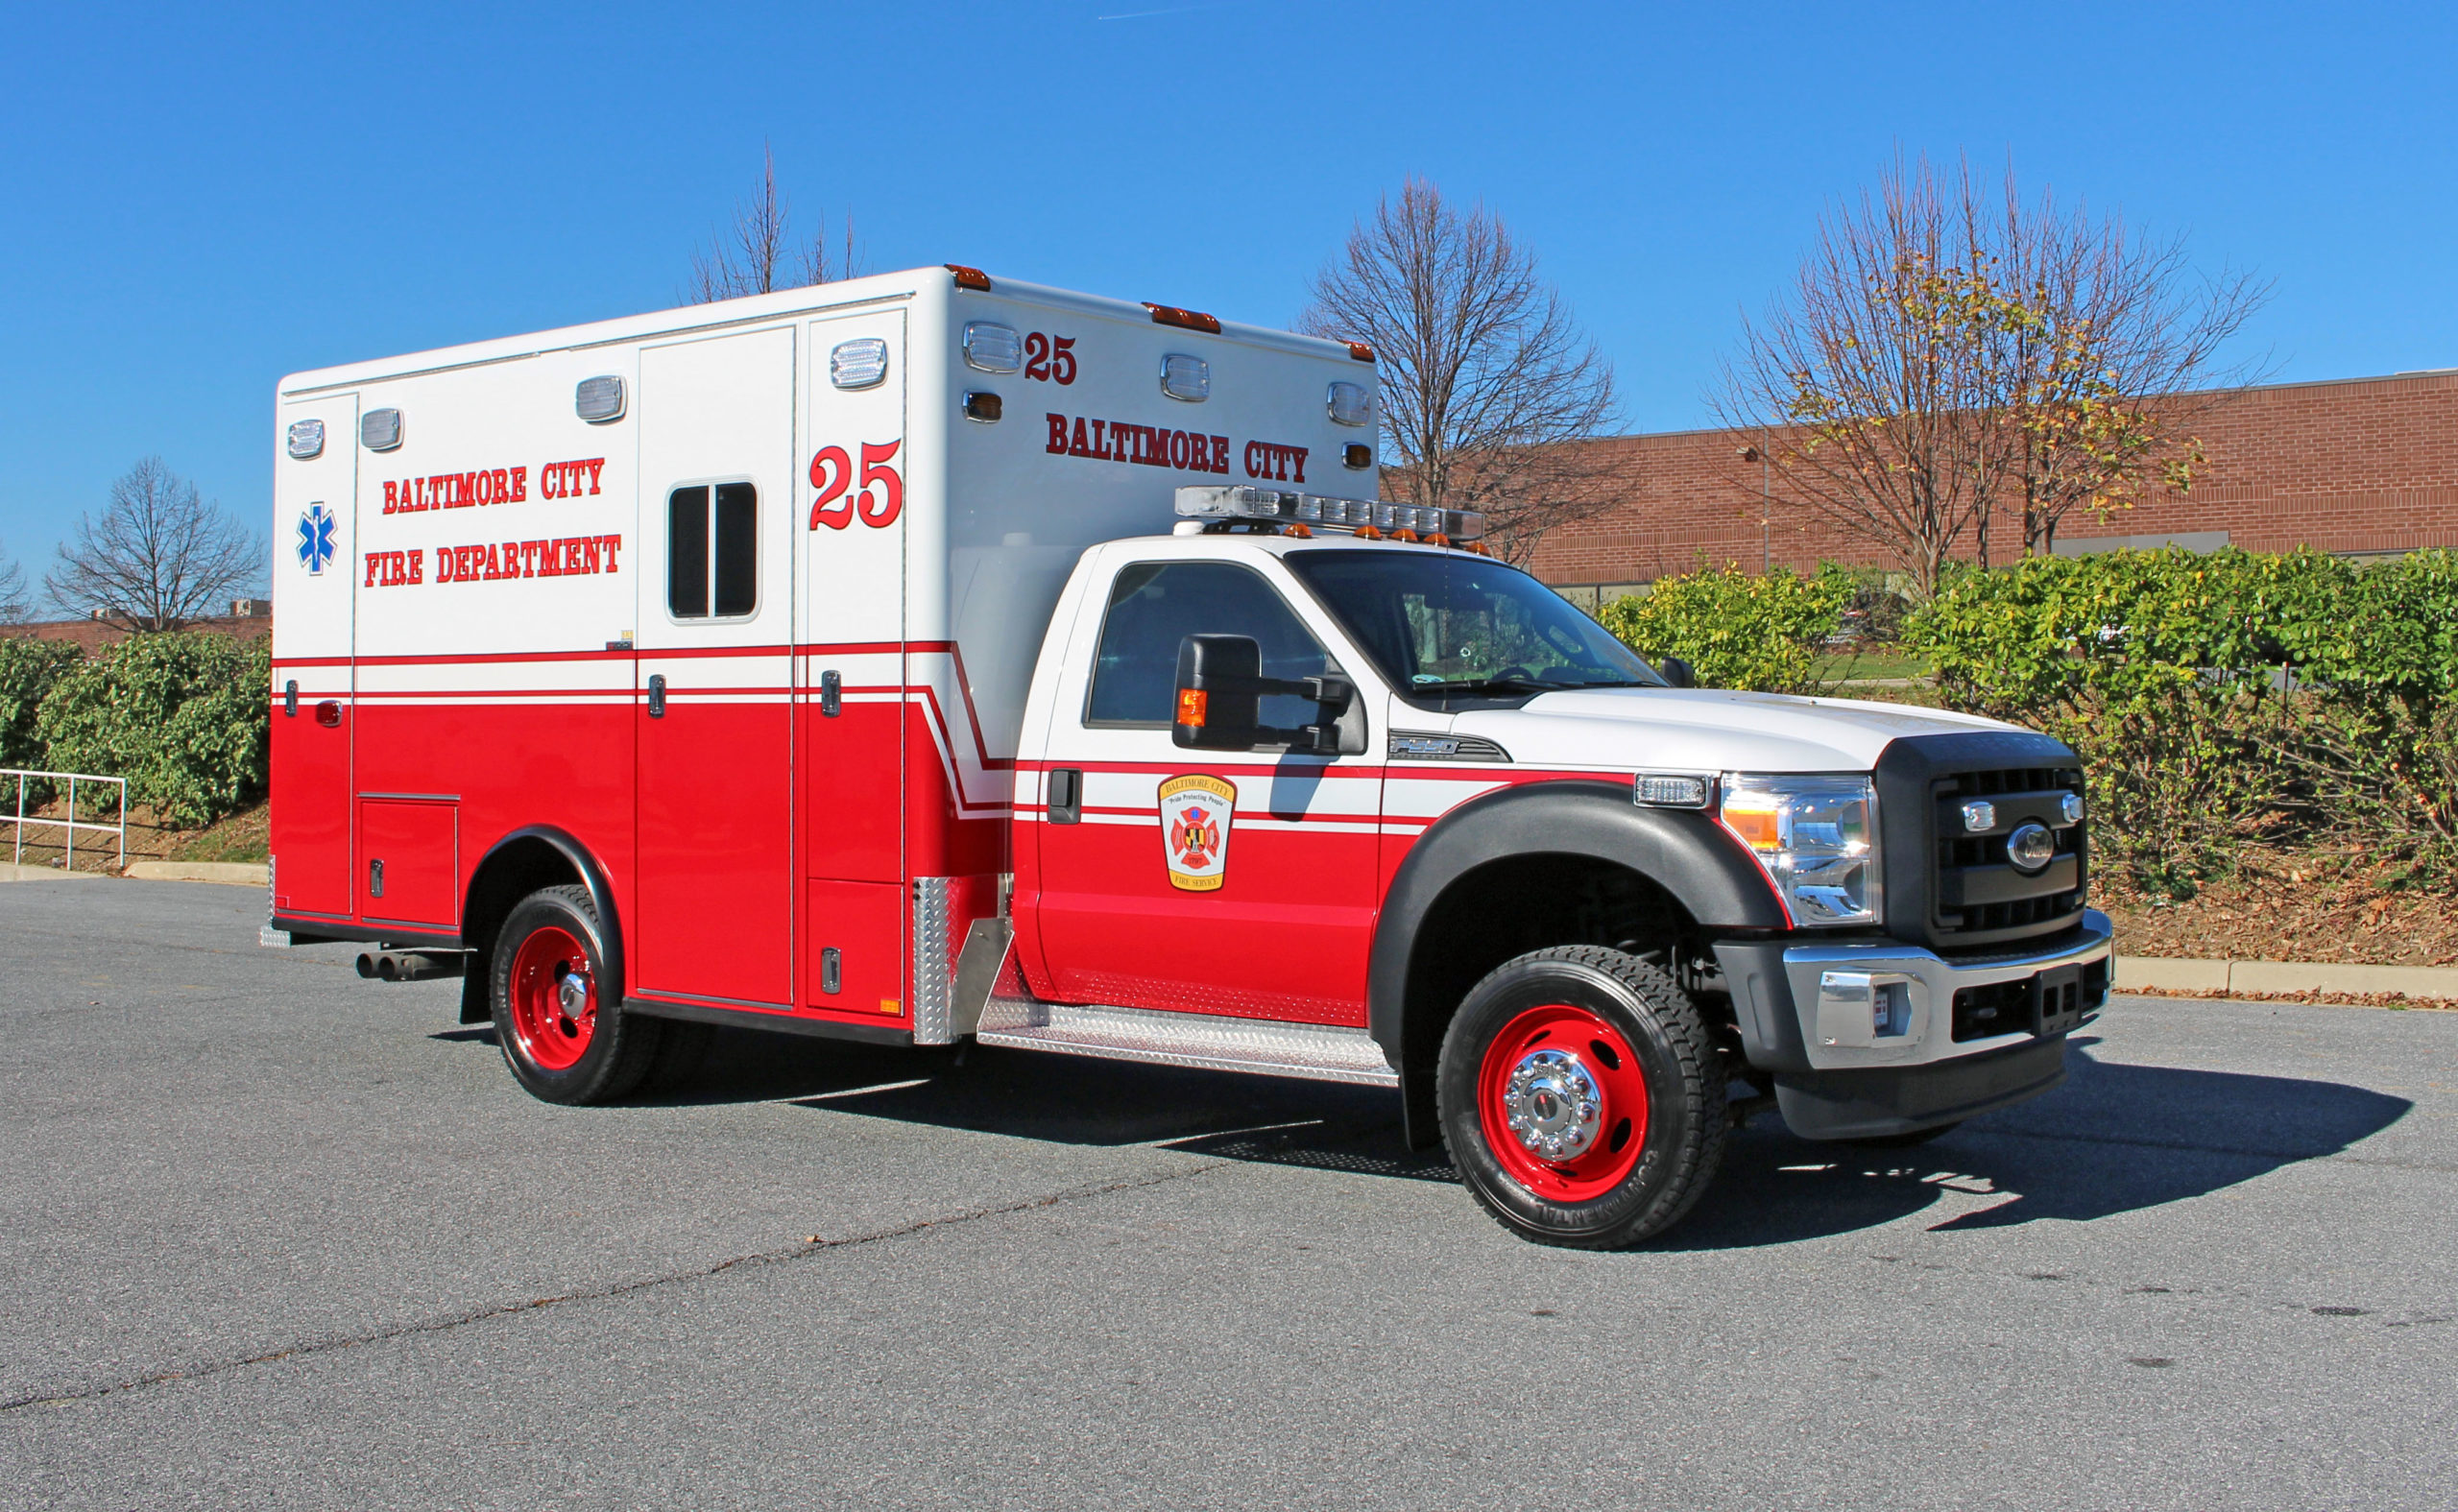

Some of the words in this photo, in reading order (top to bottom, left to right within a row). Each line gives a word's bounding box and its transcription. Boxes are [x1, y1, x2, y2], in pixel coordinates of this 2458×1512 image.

[1024, 332, 1077, 386] 25
[1046, 413, 1229, 474] BALTIMORE
[1244, 440, 1309, 483] CITY
[382, 467, 527, 515] BALTIMORE
[541, 457, 605, 499] CITY
[809, 438, 903, 531] 25
[364, 549, 423, 588] FIRE
[436, 534, 621, 583] DEPARTMENT
[1166, 778, 1209, 793] BALTIMORE
[1211, 782, 1230, 796] CITY
[2024, 831, 2048, 858] Ford
[1174, 875, 1190, 886] FIRE
